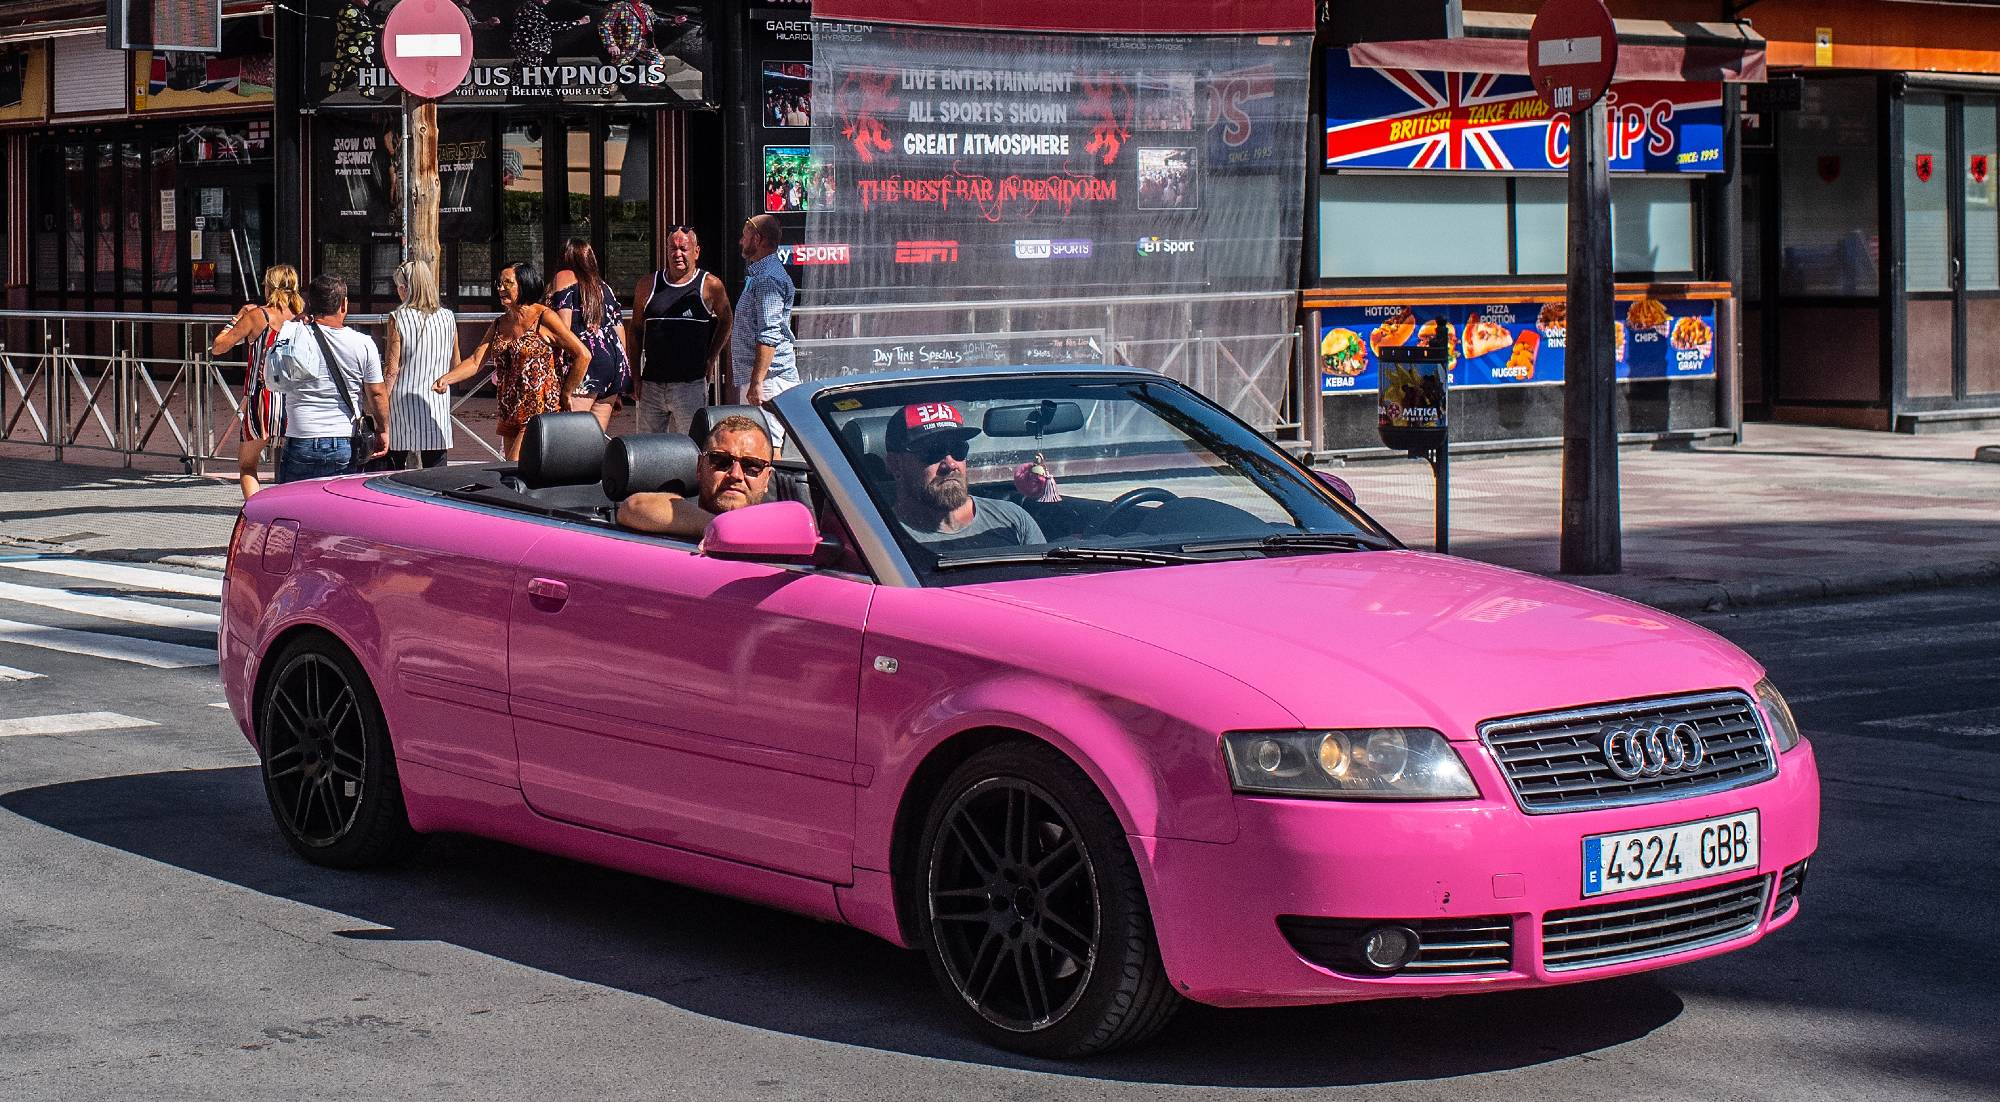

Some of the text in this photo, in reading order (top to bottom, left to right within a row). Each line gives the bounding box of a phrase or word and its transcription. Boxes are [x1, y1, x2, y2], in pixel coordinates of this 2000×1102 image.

[766, 20, 873, 33] GARETH FULTON
[776, 33, 820, 41] HILARIOUS
[522, 64, 667, 87] HYPNOSIS
[902, 69, 1073, 93] LIVE ENTERTAINMENT
[455, 85, 610, 97] YOU WON'T BELIEVE YOUR EYES
[908, 100, 1067, 124] ALL SPORTS SHOWN
[1389, 111, 1452, 142] BRITISH
[1468, 103, 1505, 124] TAKE
[903, 132, 1069, 156] GREAT ATMOSPHERE
[858, 175, 899, 214] THE
[904, 175, 953, 212] BEST
[957, 175, 994, 203] BAR
[1023, 174, 1117, 215] BENIDORM
[896, 240, 958, 263] ESPN
[1163, 239, 1195, 255] Sport
[796, 246, 846, 262] SPORT
[1365, 306, 1401, 317] HOT DOG
[1486, 305, 1509, 315] PIZZA
[1480, 315, 1515, 324] PORTION
[1634, 332, 1659, 343] CHIPS
[873, 348, 893, 367] Day
[1676, 350, 1698, 361] CHIPS
[1492, 366, 1528, 378] NUGGETS
[1678, 360, 1704, 371] GRAVY
[1325, 377, 1355, 388] KEBAB
[1606, 820, 1748, 884] 4324 GBB
[1590, 871, 1598, 883] E
